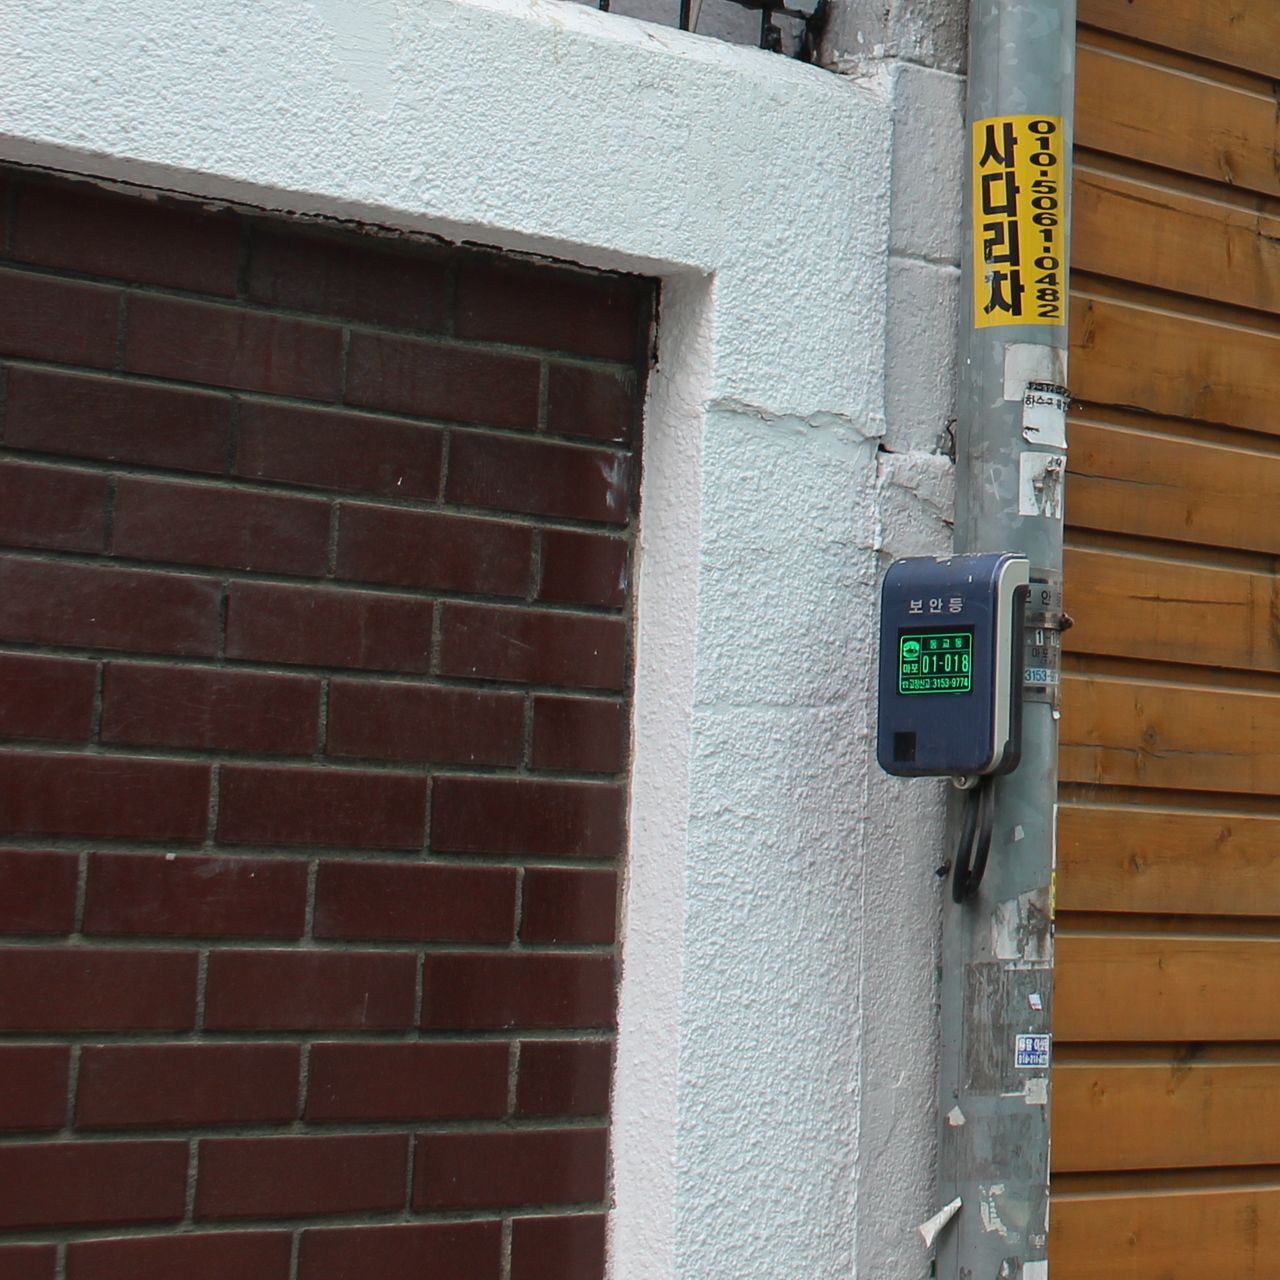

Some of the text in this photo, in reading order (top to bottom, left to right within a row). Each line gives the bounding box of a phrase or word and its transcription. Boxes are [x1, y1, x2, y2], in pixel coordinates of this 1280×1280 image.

[979, 121, 1025, 317] 사다리차
[909, 597, 963, 614] 보안등
[922, 653, 970, 673] 01-018
